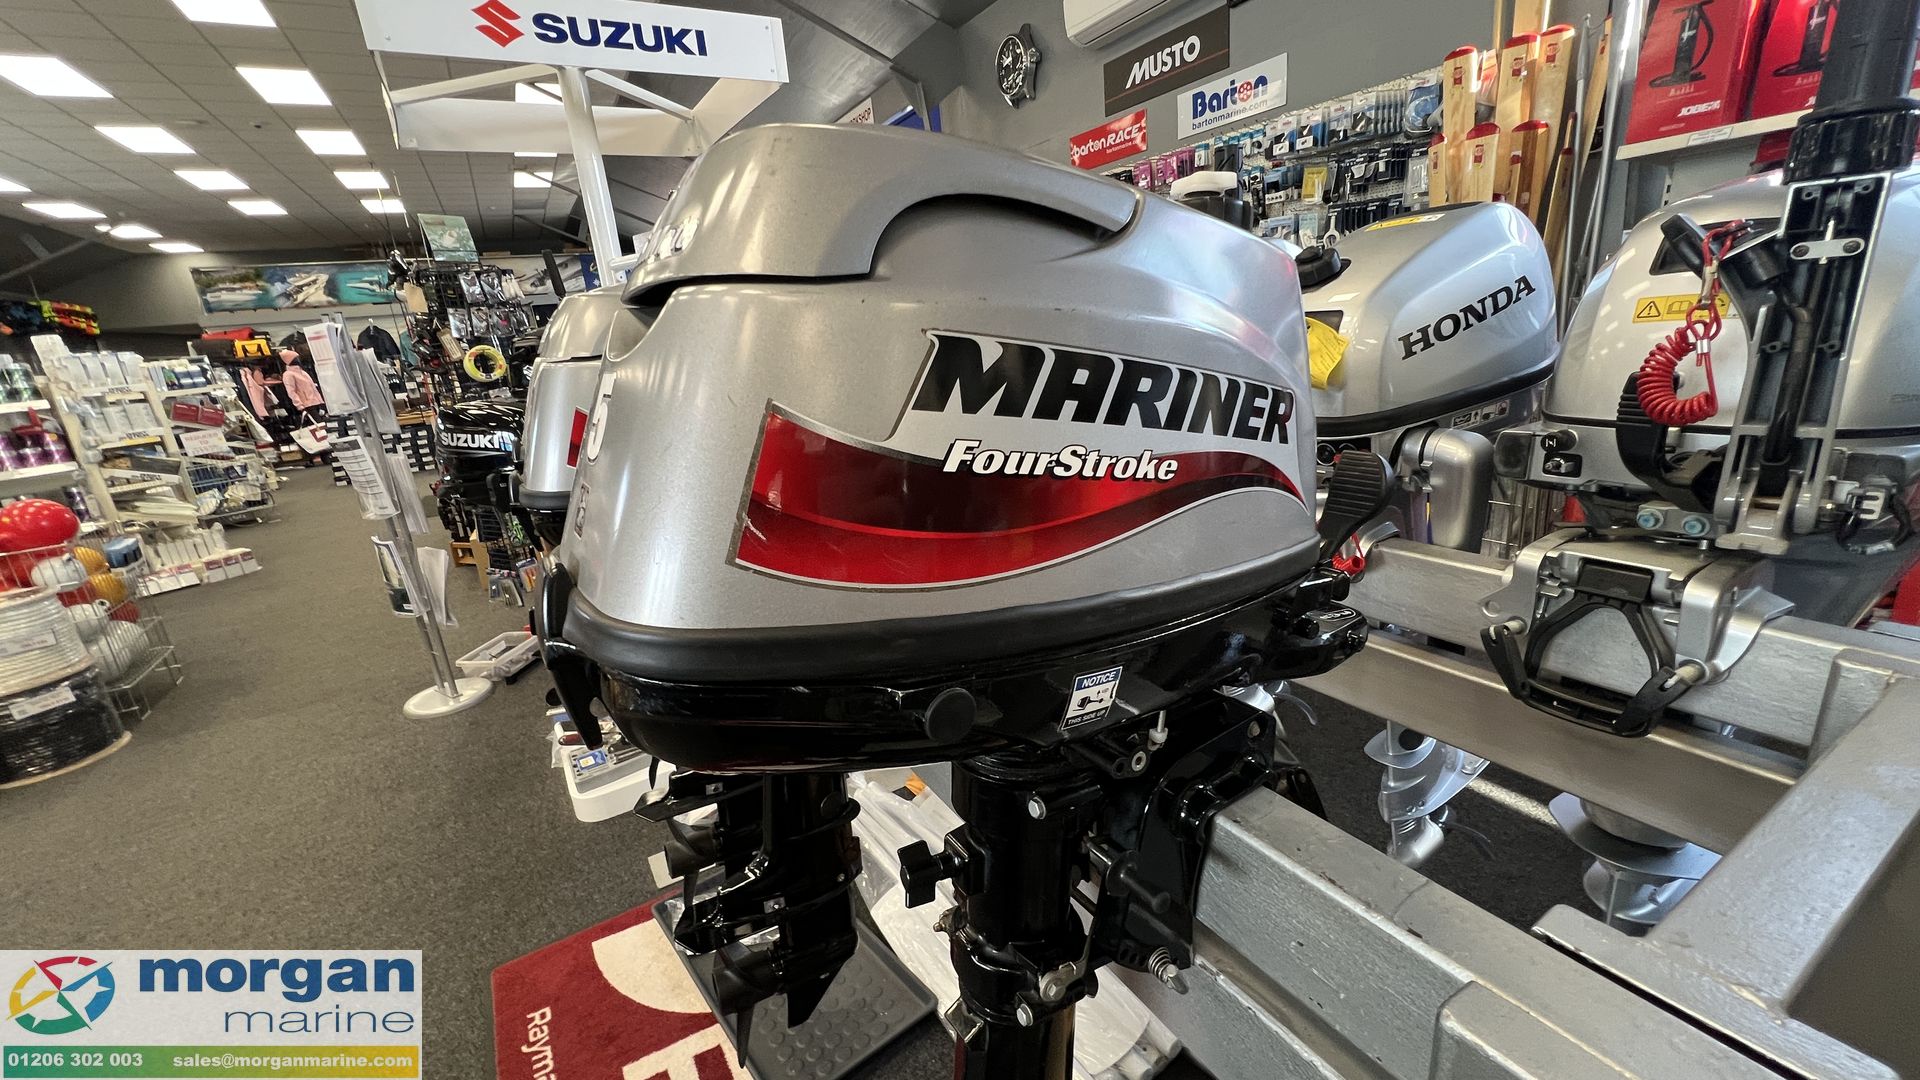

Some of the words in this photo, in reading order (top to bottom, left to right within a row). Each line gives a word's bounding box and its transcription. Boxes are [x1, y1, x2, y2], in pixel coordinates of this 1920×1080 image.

[532, 12, 708, 57] SUZUKI
[1125, 35, 1201, 90] MUSTO
[1192, 75, 1268, 119] Barton
[1192, 99, 1268, 131] bartonmarine.com
[1398, 274, 1536, 360] HONDA
[911, 334, 1294, 444] MARINER
[440, 431, 500, 449] SUZUKI
[942, 438, 1179, 482] FourStroke
[1081, 671, 1116, 688] NOTICE
[521, 1006, 557, 1080] Raym
